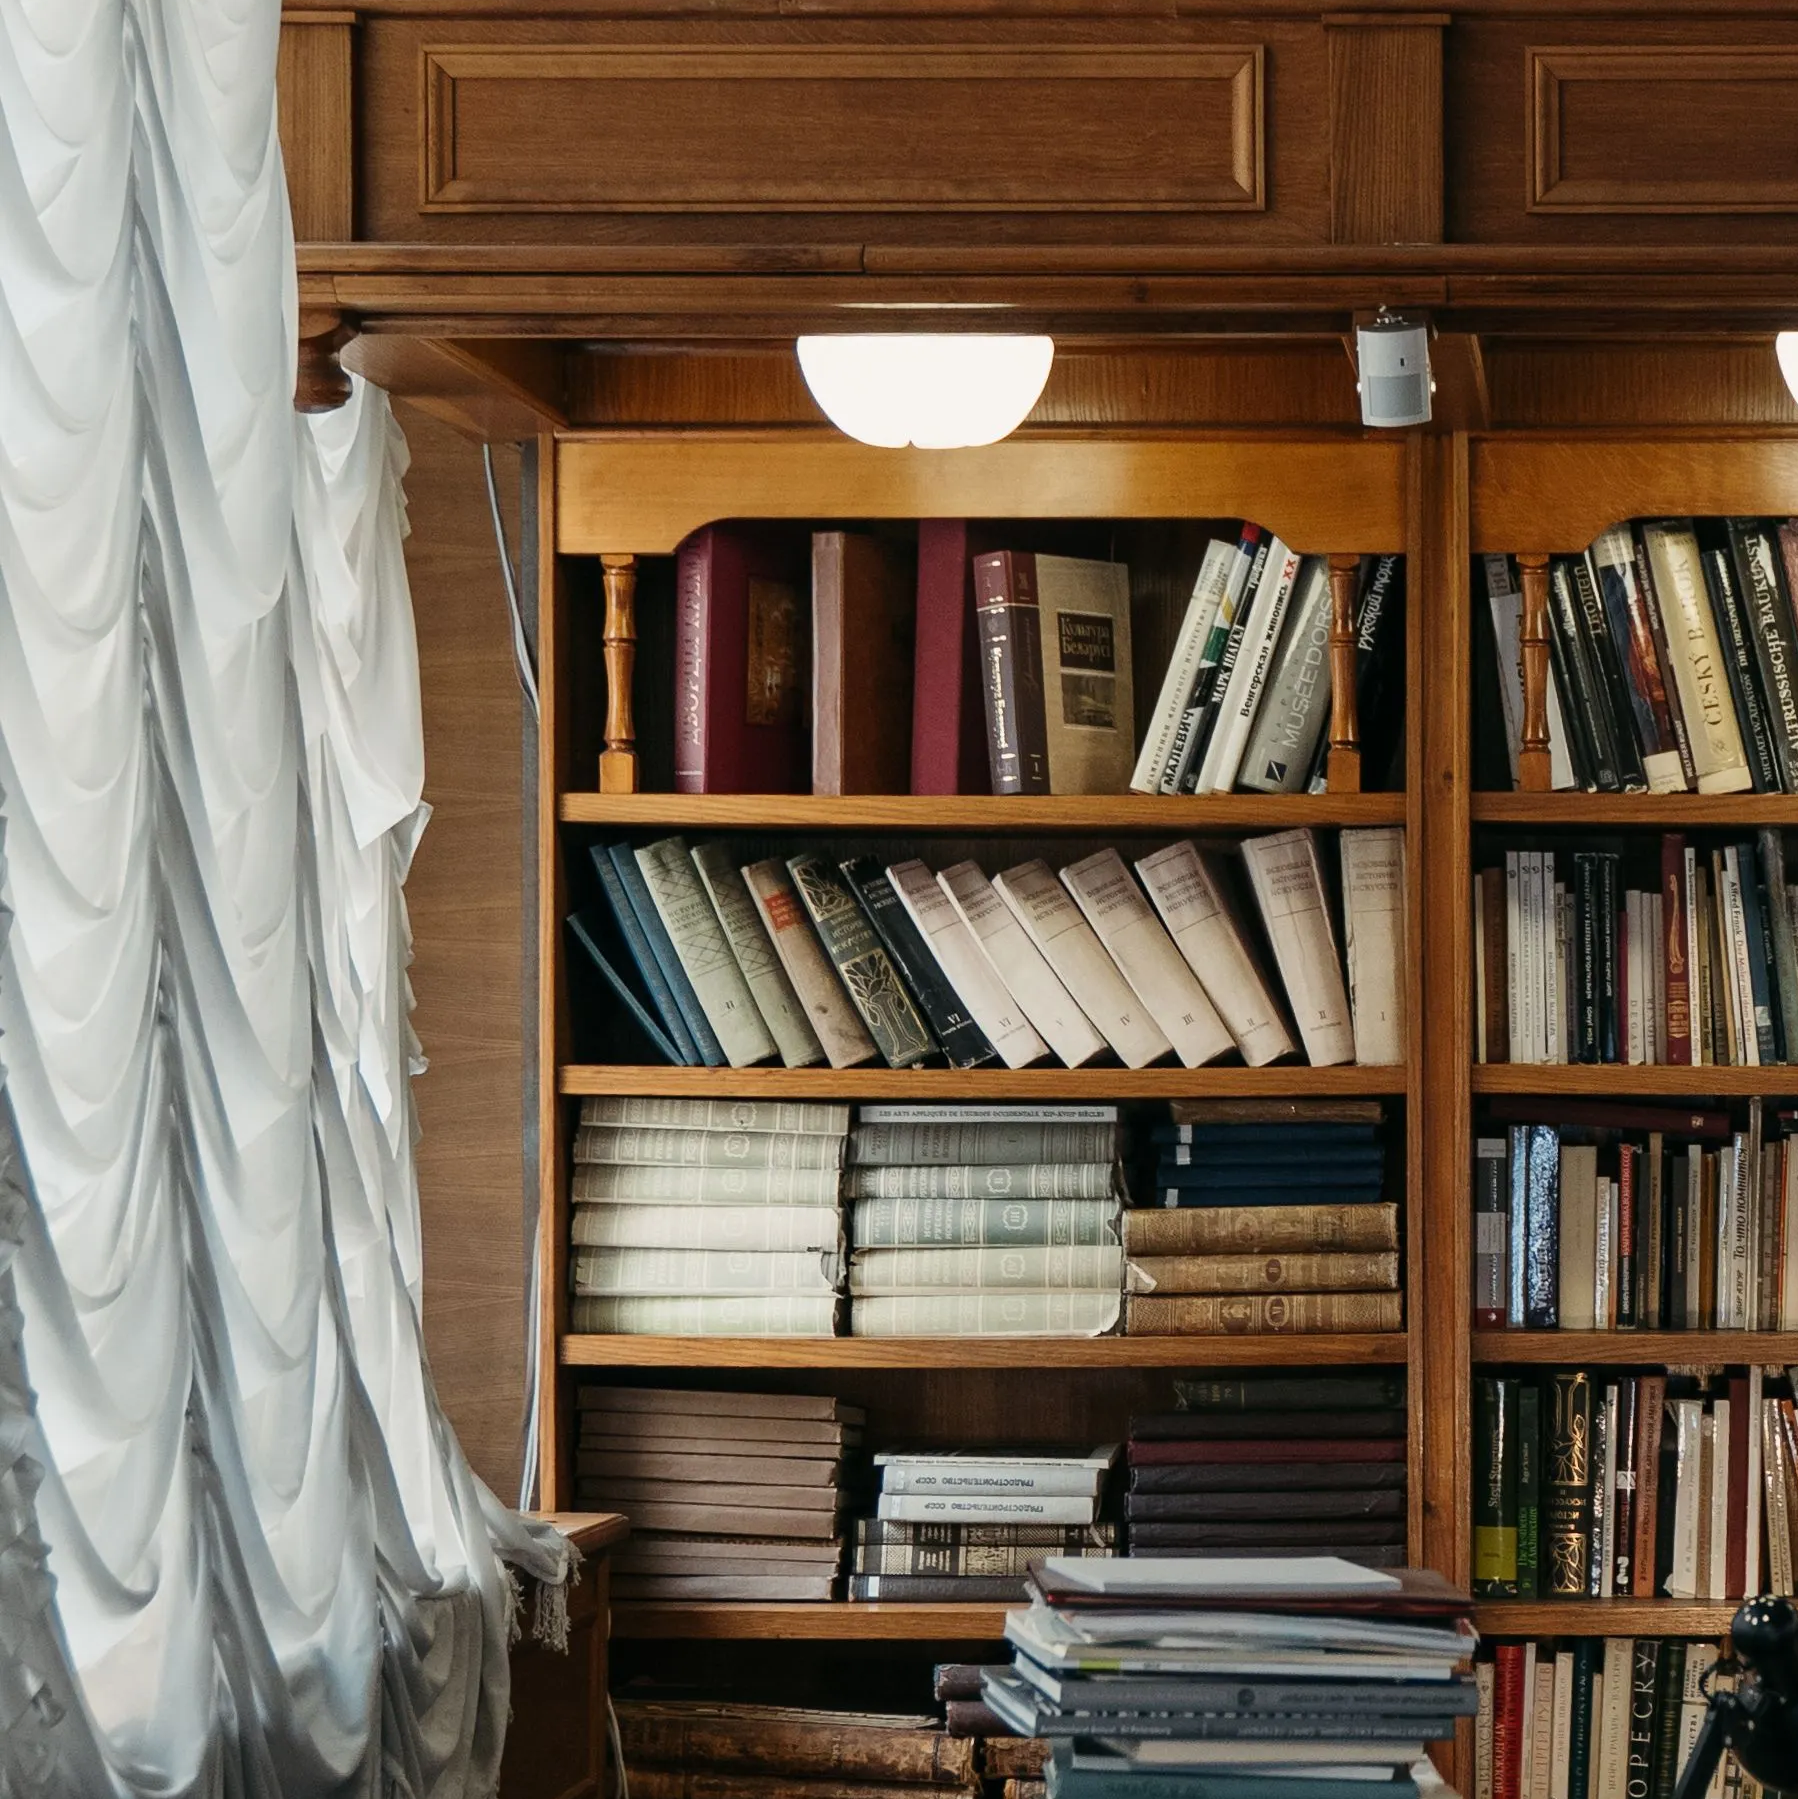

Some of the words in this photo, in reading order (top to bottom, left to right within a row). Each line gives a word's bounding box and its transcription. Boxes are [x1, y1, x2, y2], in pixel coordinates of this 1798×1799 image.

[1220, 623, 1245, 666] ШАГАЛ
[1239, 645, 1270, 717] Венгерская
[1260, 583, 1289, 641] живопись
[1211, 668, 1232, 703] МАРК
[1688, 650, 1724, 726] ČESKÝ
[1161, 708, 1195, 785] МАЛЕВИЧ
[1729, 881, 1741, 910] Alfred
[1731, 910, 1743, 937] Frank
[1734, 1146, 1748, 1212] помнится
[1734, 1214, 1748, 1242] что
[1733, 1245, 1746, 1260] То
[1488, 1427, 1500, 1479] Structures
[914, 1476, 939, 1488] СССР
[1487, 1479, 1500, 1507] Steel
[923, 1501, 947, 1514] СССР
[1517, 1505, 1530, 1547] Aesthetics
[1527, 1504, 1538, 1558] Architecture
[1517, 1548, 1529, 1565] The
[1527, 1558, 1538, 1568] of
